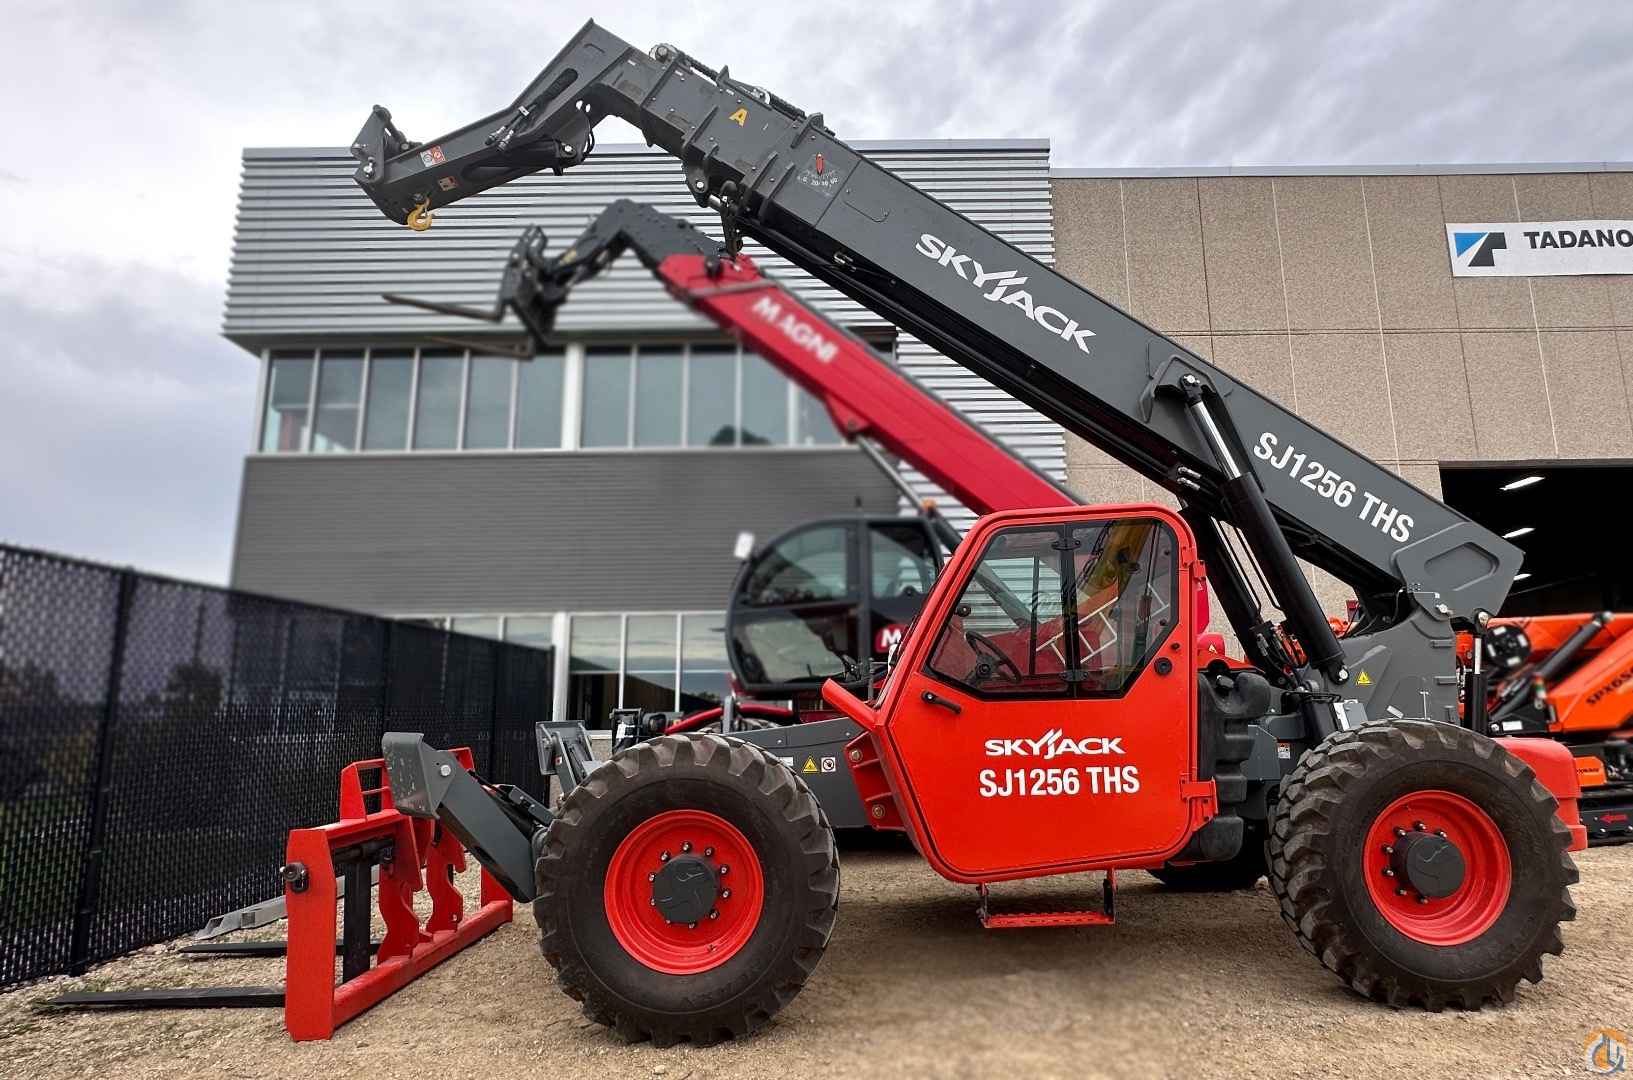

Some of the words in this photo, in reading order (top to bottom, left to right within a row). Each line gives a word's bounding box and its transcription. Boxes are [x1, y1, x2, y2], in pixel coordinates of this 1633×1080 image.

[1523, 229, 1633, 249] TADANO
[915, 233, 1097, 354] SKYJACK
[751, 296, 839, 363] MAGNI
[1253, 432, 1356, 508] SJ1256
[1359, 491, 1414, 543] THS
[984, 728, 1127, 760] SKYJACK
[979, 767, 1080, 797] SJ1256
[1085, 765, 1140, 794] THS
